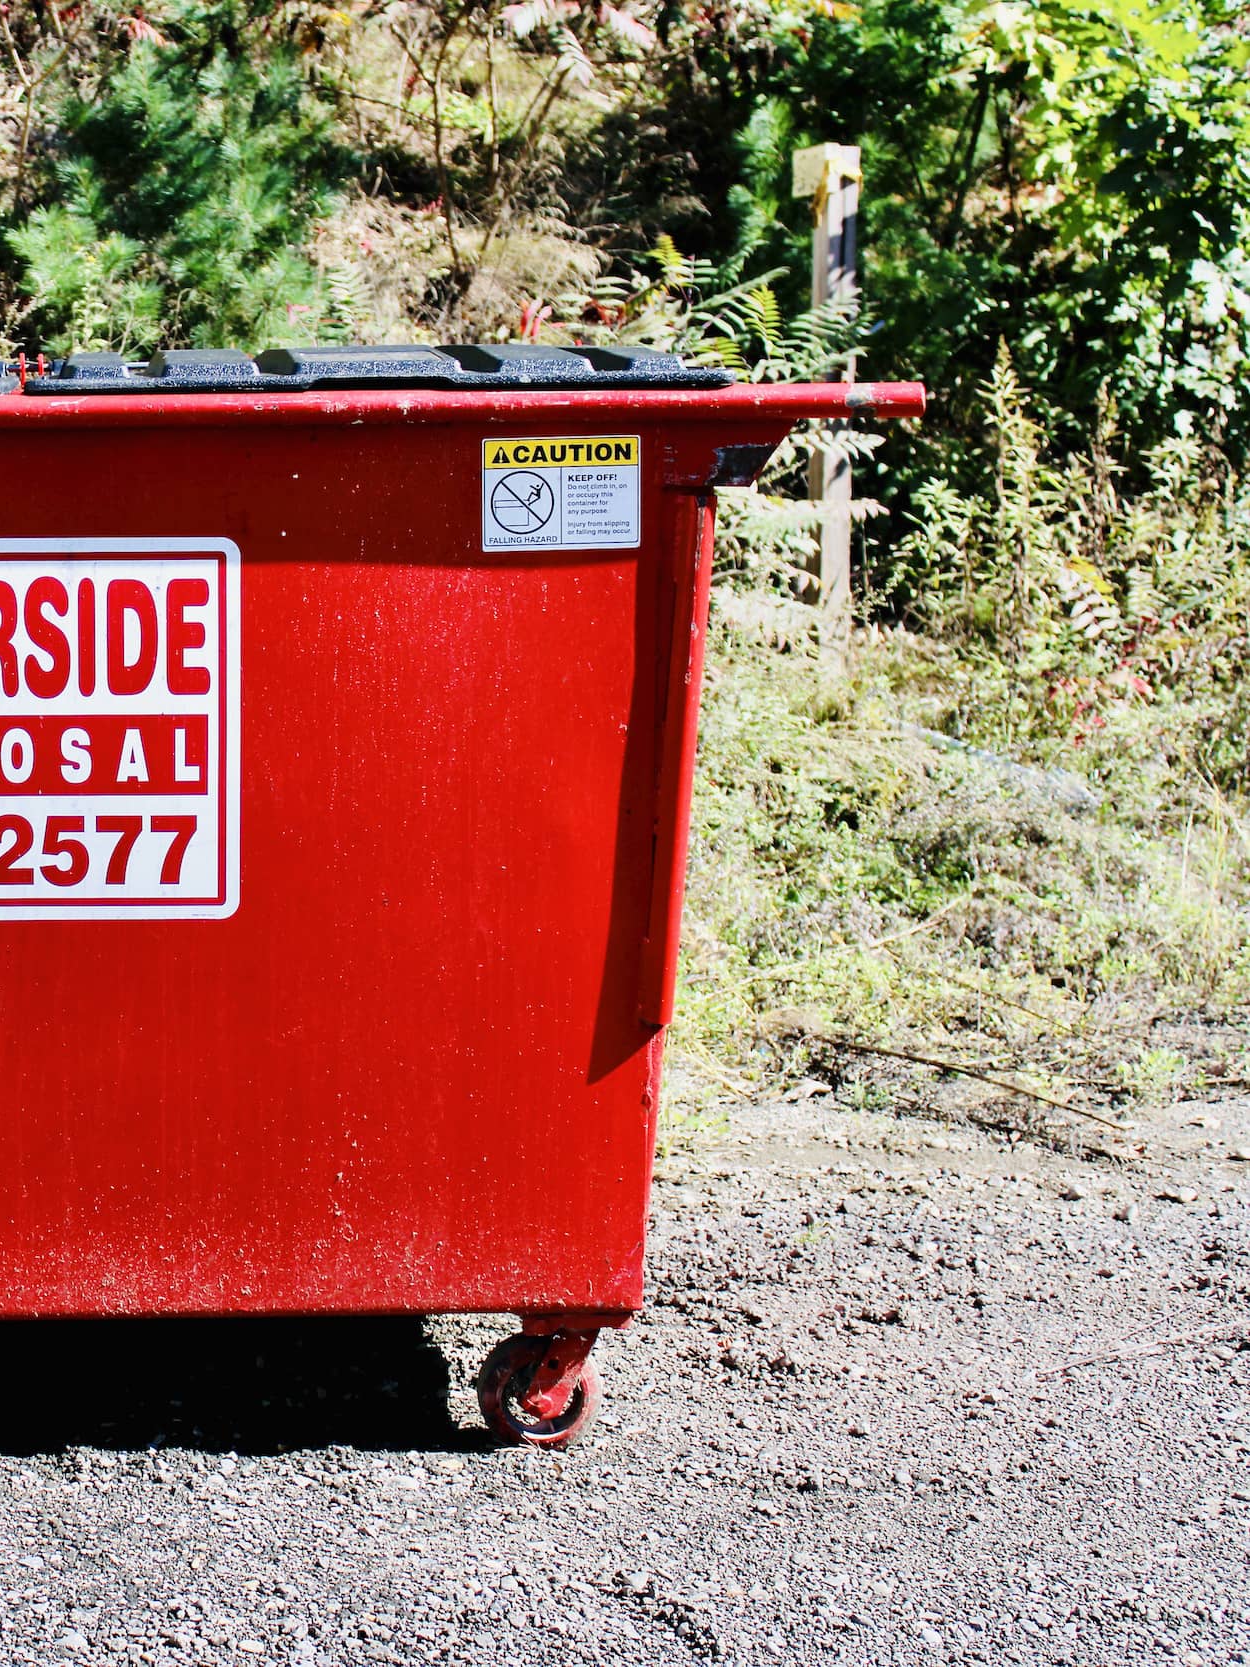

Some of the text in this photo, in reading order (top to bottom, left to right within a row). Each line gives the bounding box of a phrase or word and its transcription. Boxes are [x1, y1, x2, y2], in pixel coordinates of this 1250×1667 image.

[513, 443, 631, 463] CAUTION
[568, 474, 593, 482] KEEP
[604, 520, 630, 528] slipping
[489, 535, 558, 544] FALLING HAZARD
